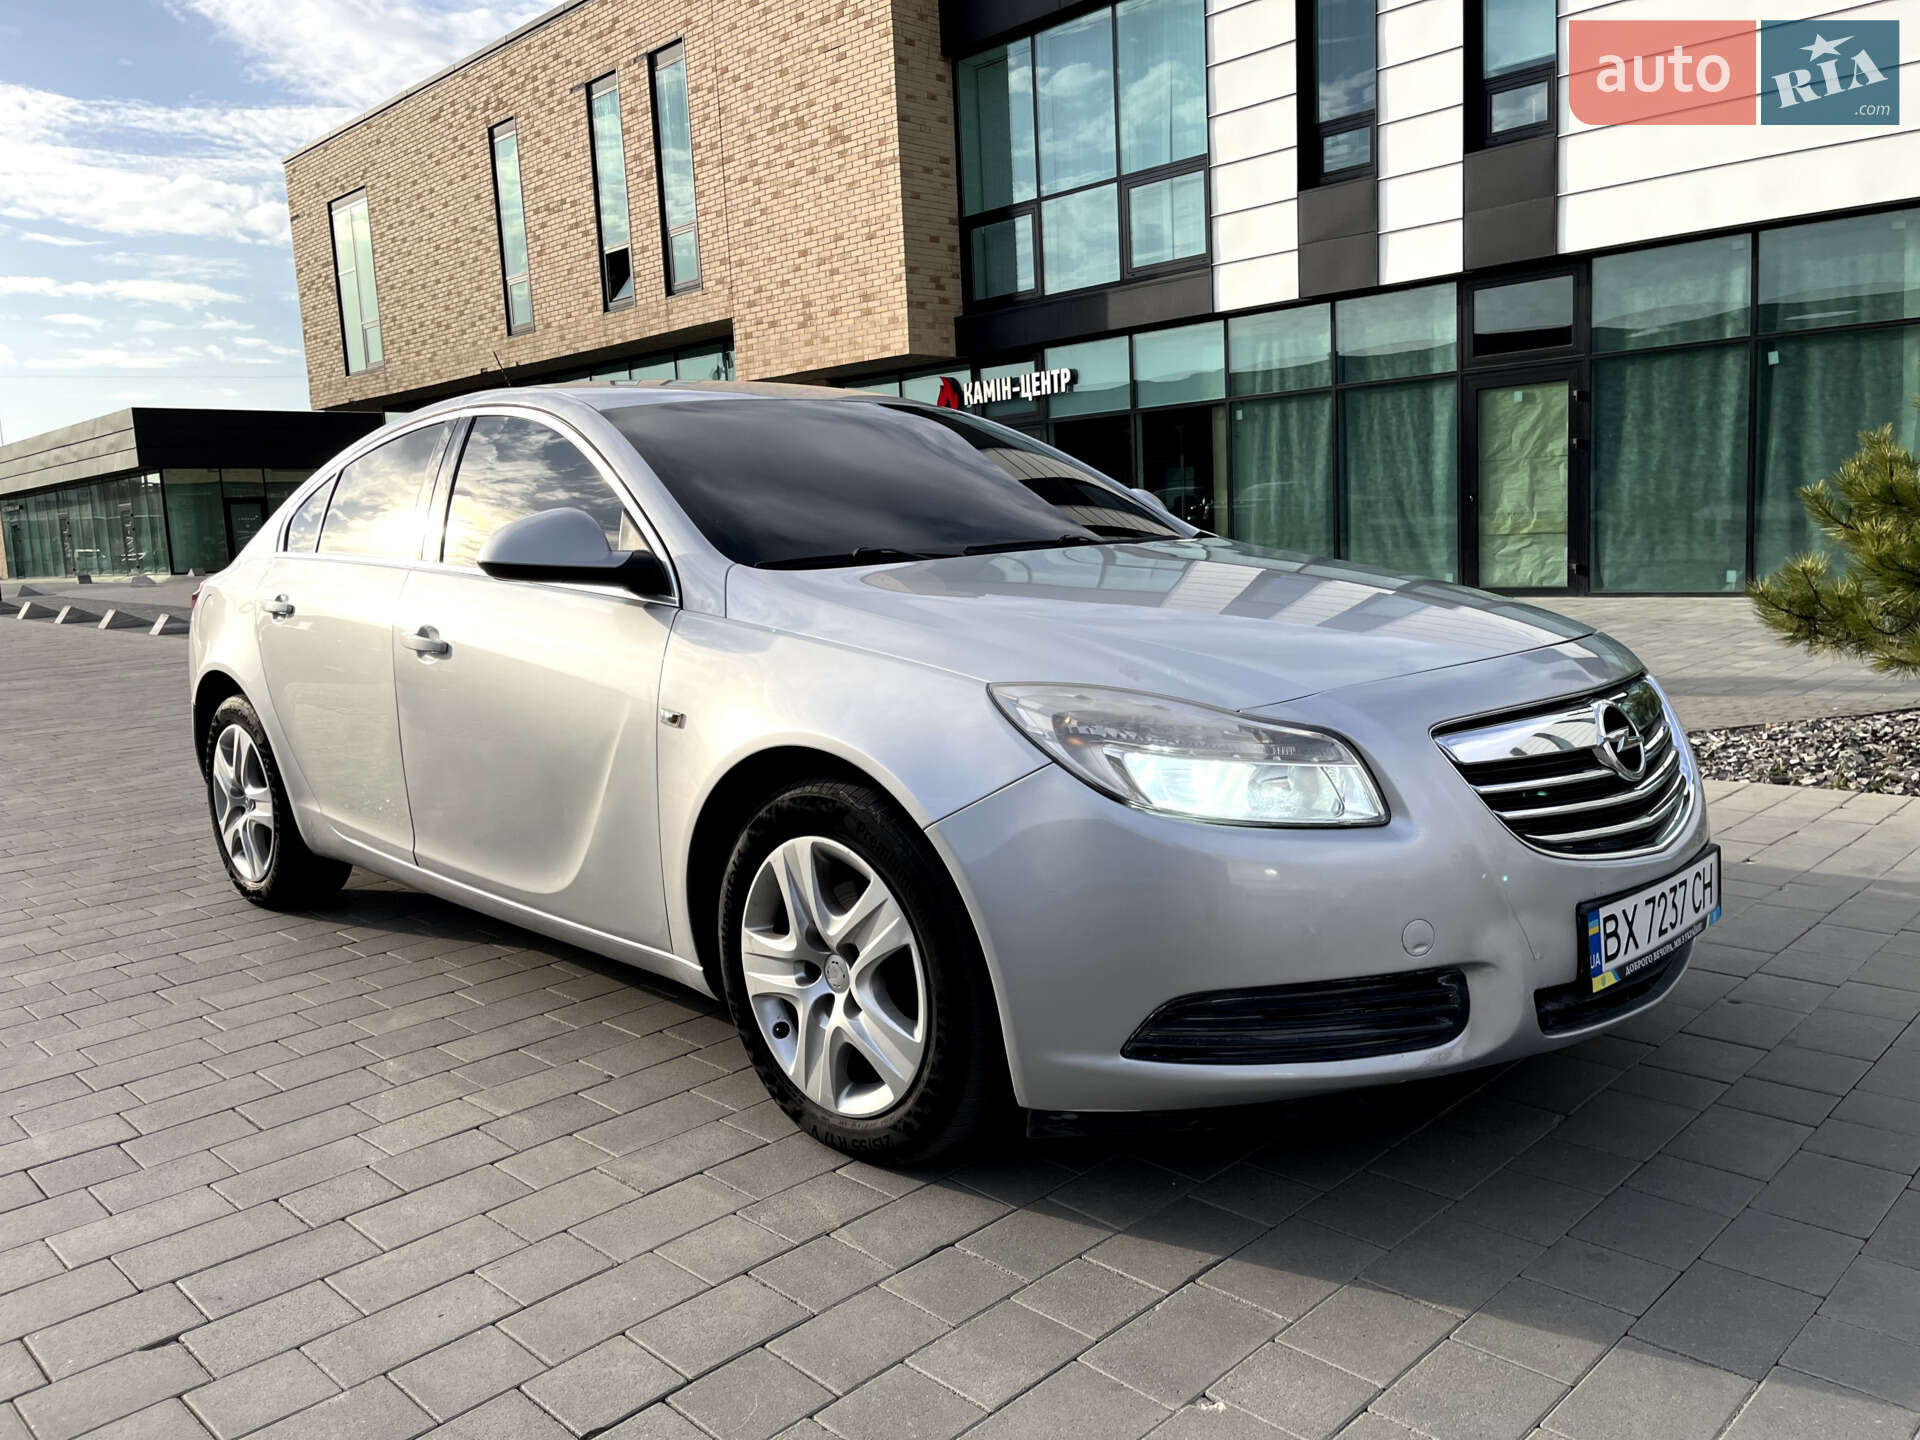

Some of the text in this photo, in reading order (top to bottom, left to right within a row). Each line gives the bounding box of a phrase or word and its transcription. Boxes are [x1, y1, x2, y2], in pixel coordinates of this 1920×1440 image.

[963, 367, 1071, 406] КАМІН-ЦЕНТР
[1603, 863, 1713, 963] BX 7237 CH
